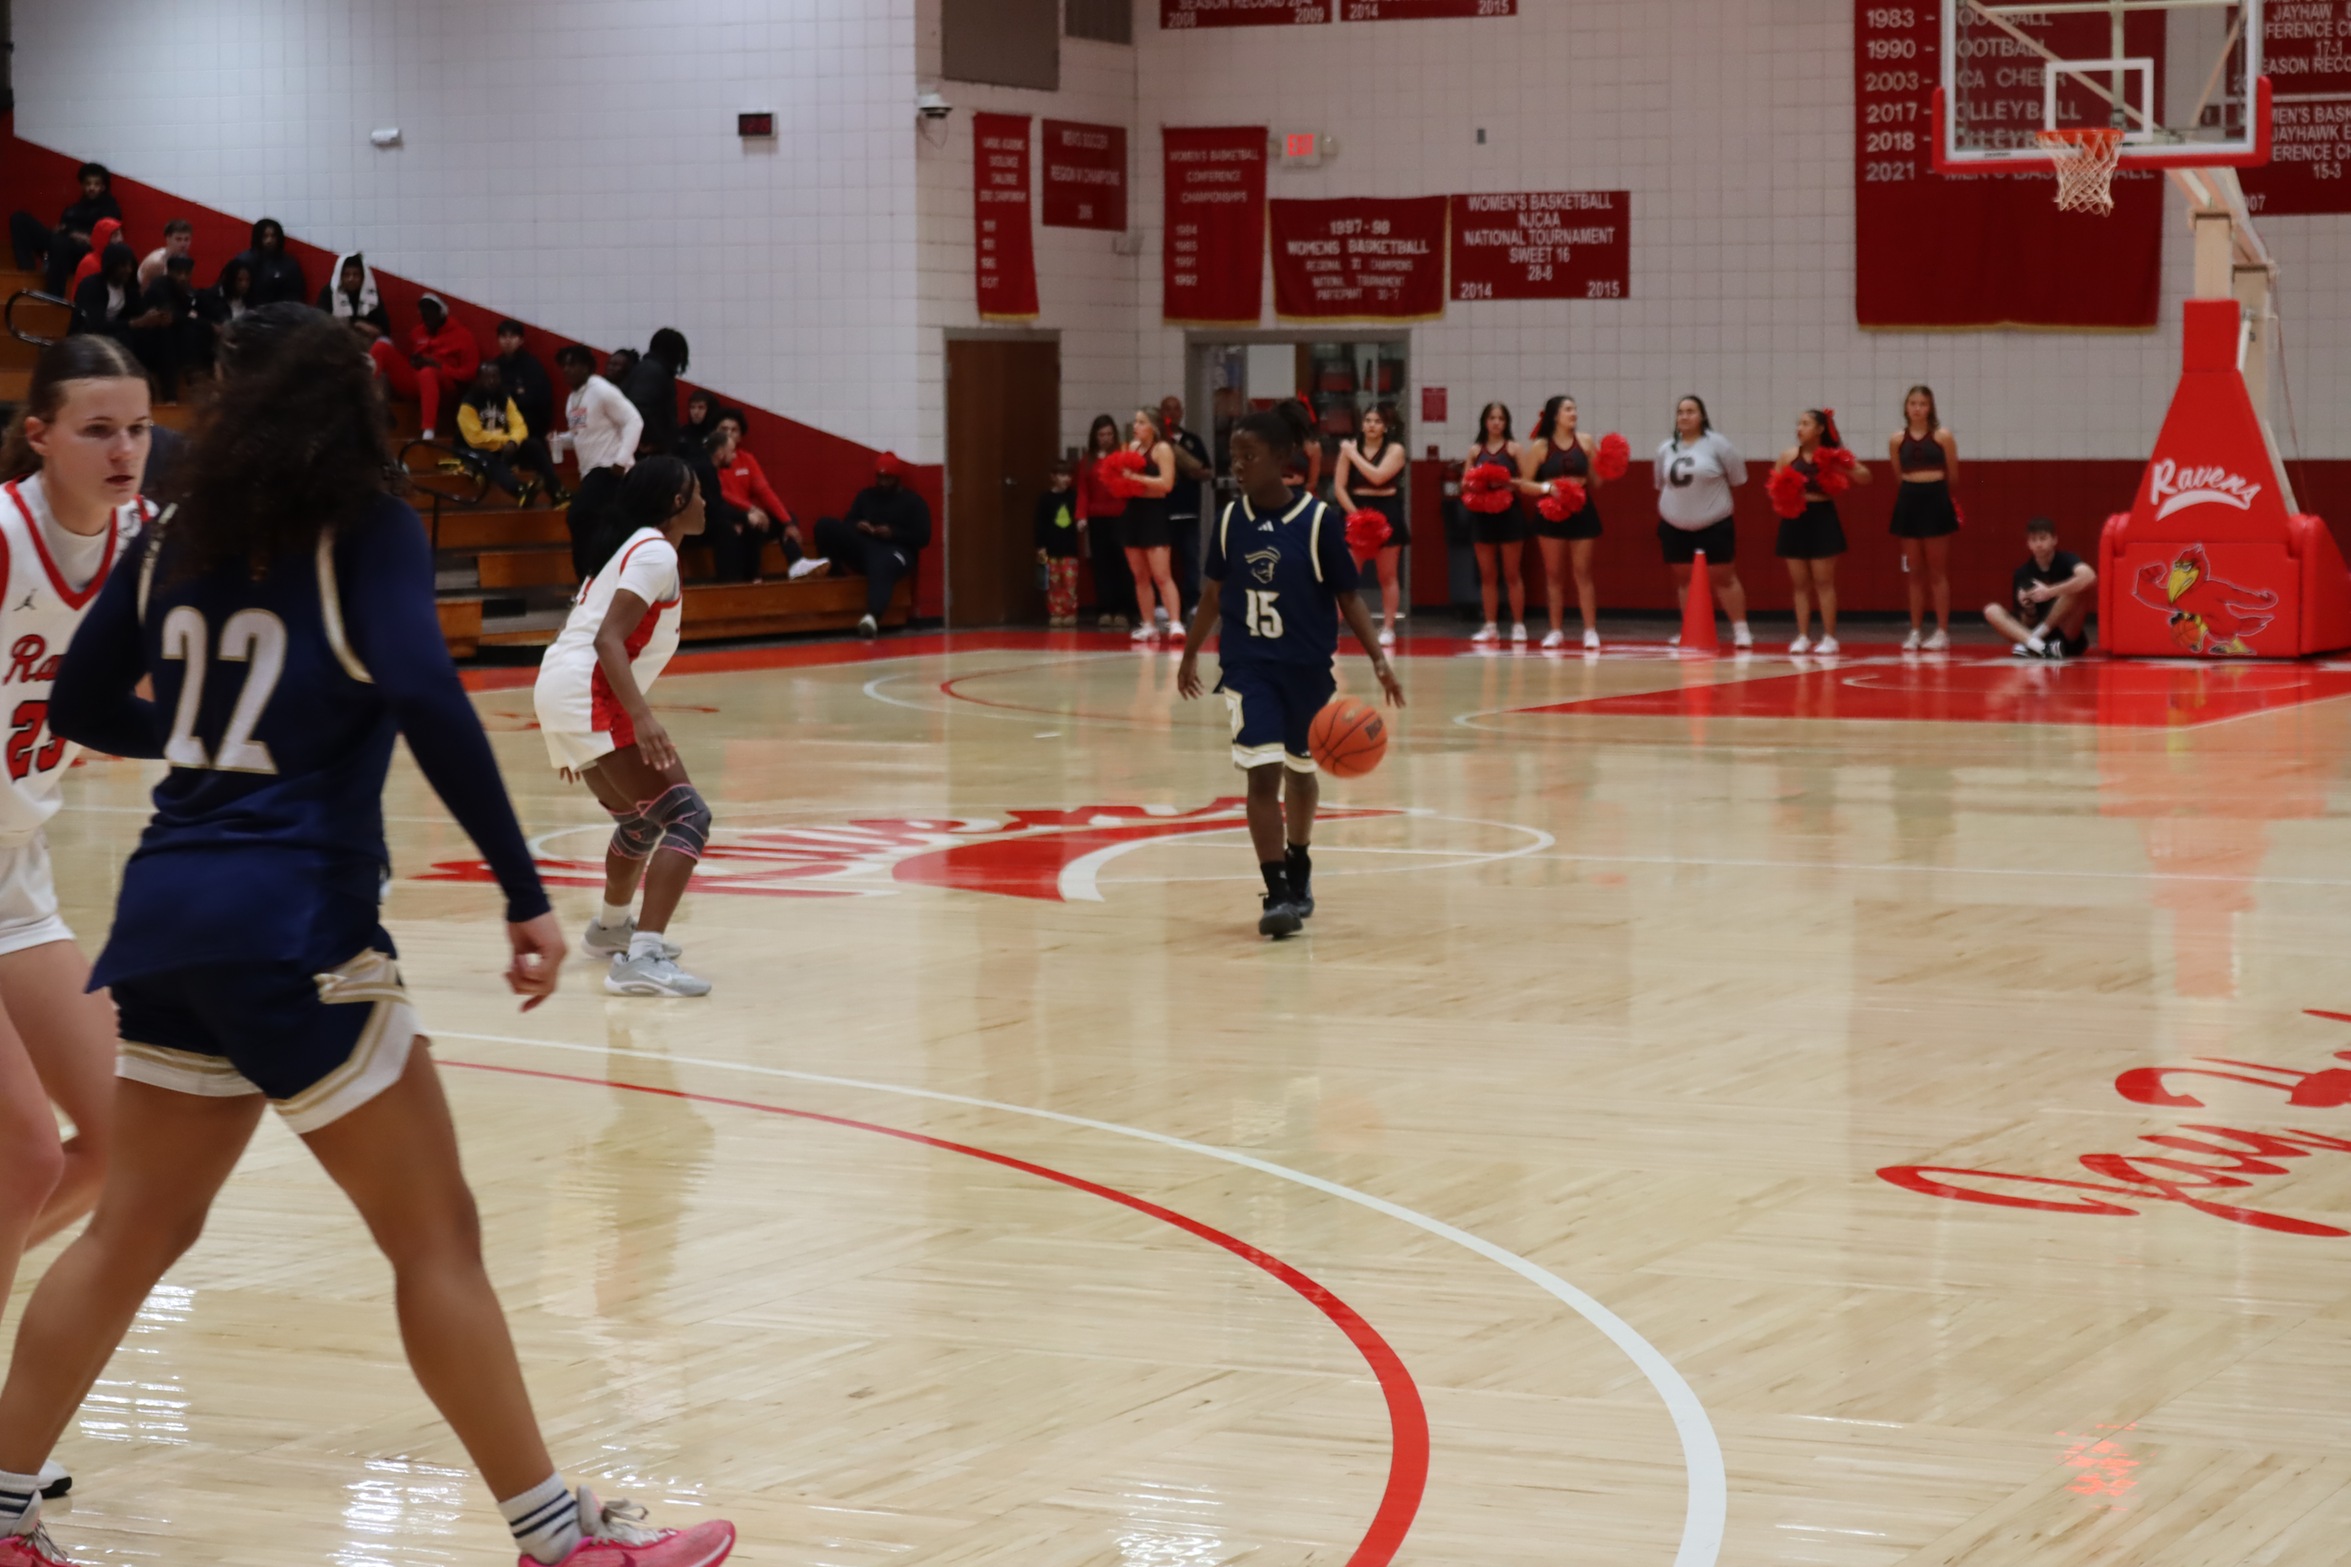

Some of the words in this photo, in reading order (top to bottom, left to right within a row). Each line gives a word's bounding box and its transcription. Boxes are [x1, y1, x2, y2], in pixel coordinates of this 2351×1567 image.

[1350, 4, 1379, 19] 2014
[1478, 0, 1509, 15] 2015
[1866, 9, 1915, 28] 1983
[2266, 22, 2334, 38] FERENCE
[1866, 39, 1917, 59] 1990
[1865, 72, 1919, 91] 2003
[1866, 102, 1918, 124] 2017
[1866, 131, 1915, 152] 2018
[1210, 150, 1260, 162] BASKETBALL
[2272, 145, 2331, 161] ERENCE
[1186, 171, 1241, 183] CONFERENCE
[1866, 161, 1915, 182] 2021
[2313, 163, 2342, 180] 15-3
[1468, 195, 1527, 212] WOMEN'S
[1530, 193, 1613, 211] BASKETBALL
[1518, 212, 1561, 229] NJCAA
[1463, 229, 1526, 246] NATIONAL
[1529, 227, 1615, 245] TOURNAMENT
[1347, 238, 1430, 255] BASKETBALL
[1509, 248, 1552, 264] SWEET
[1556, 247, 1570, 263] 16
[1370, 259, 1413, 272] CHAMPIONS
[1356, 275, 1405, 287] TOURNAMENT
[1587, 281, 1620, 298] 2015
[1460, 282, 1492, 299] 2014
[1669, 456, 1695, 488] C
[2151, 457, 2262, 511] Ravens
[1245, 588, 1284, 639] 15
[160, 604, 288, 775] 22
